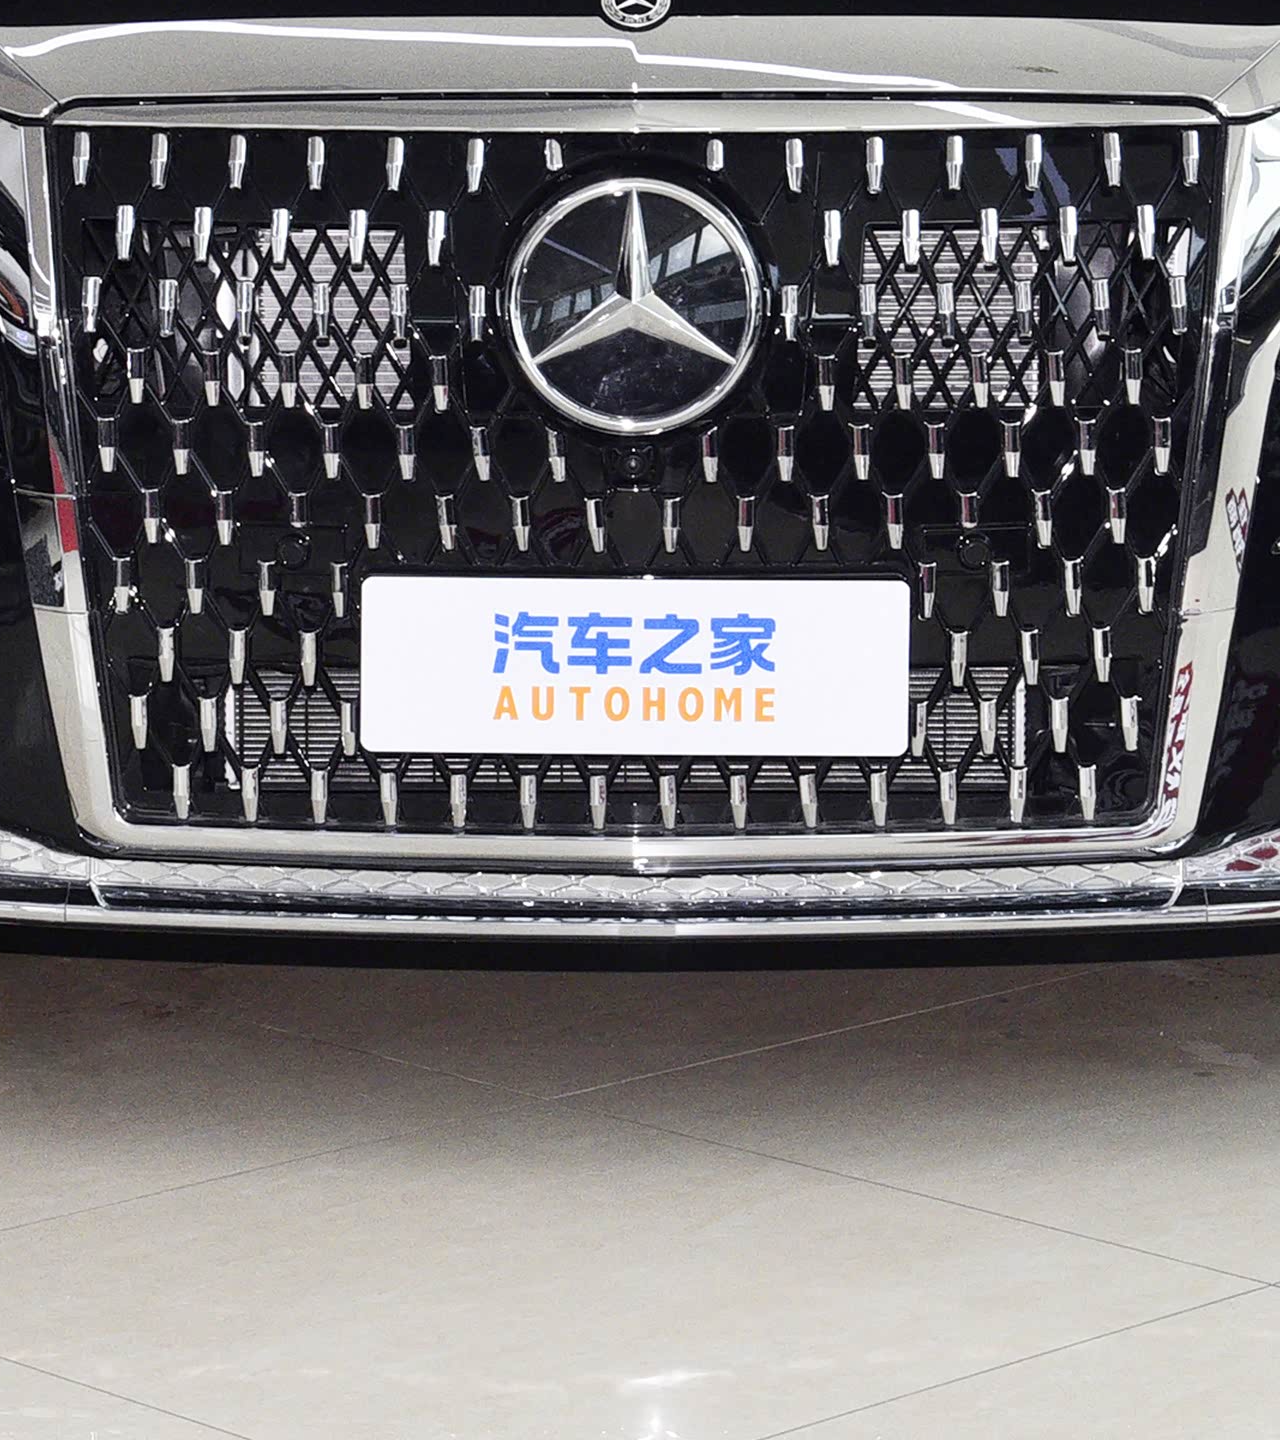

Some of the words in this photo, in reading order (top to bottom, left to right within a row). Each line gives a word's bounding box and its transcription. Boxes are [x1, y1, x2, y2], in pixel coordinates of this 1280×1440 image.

[492, 611, 777, 676] 汽车之家
[492, 685, 776, 723] AUTOHOME
